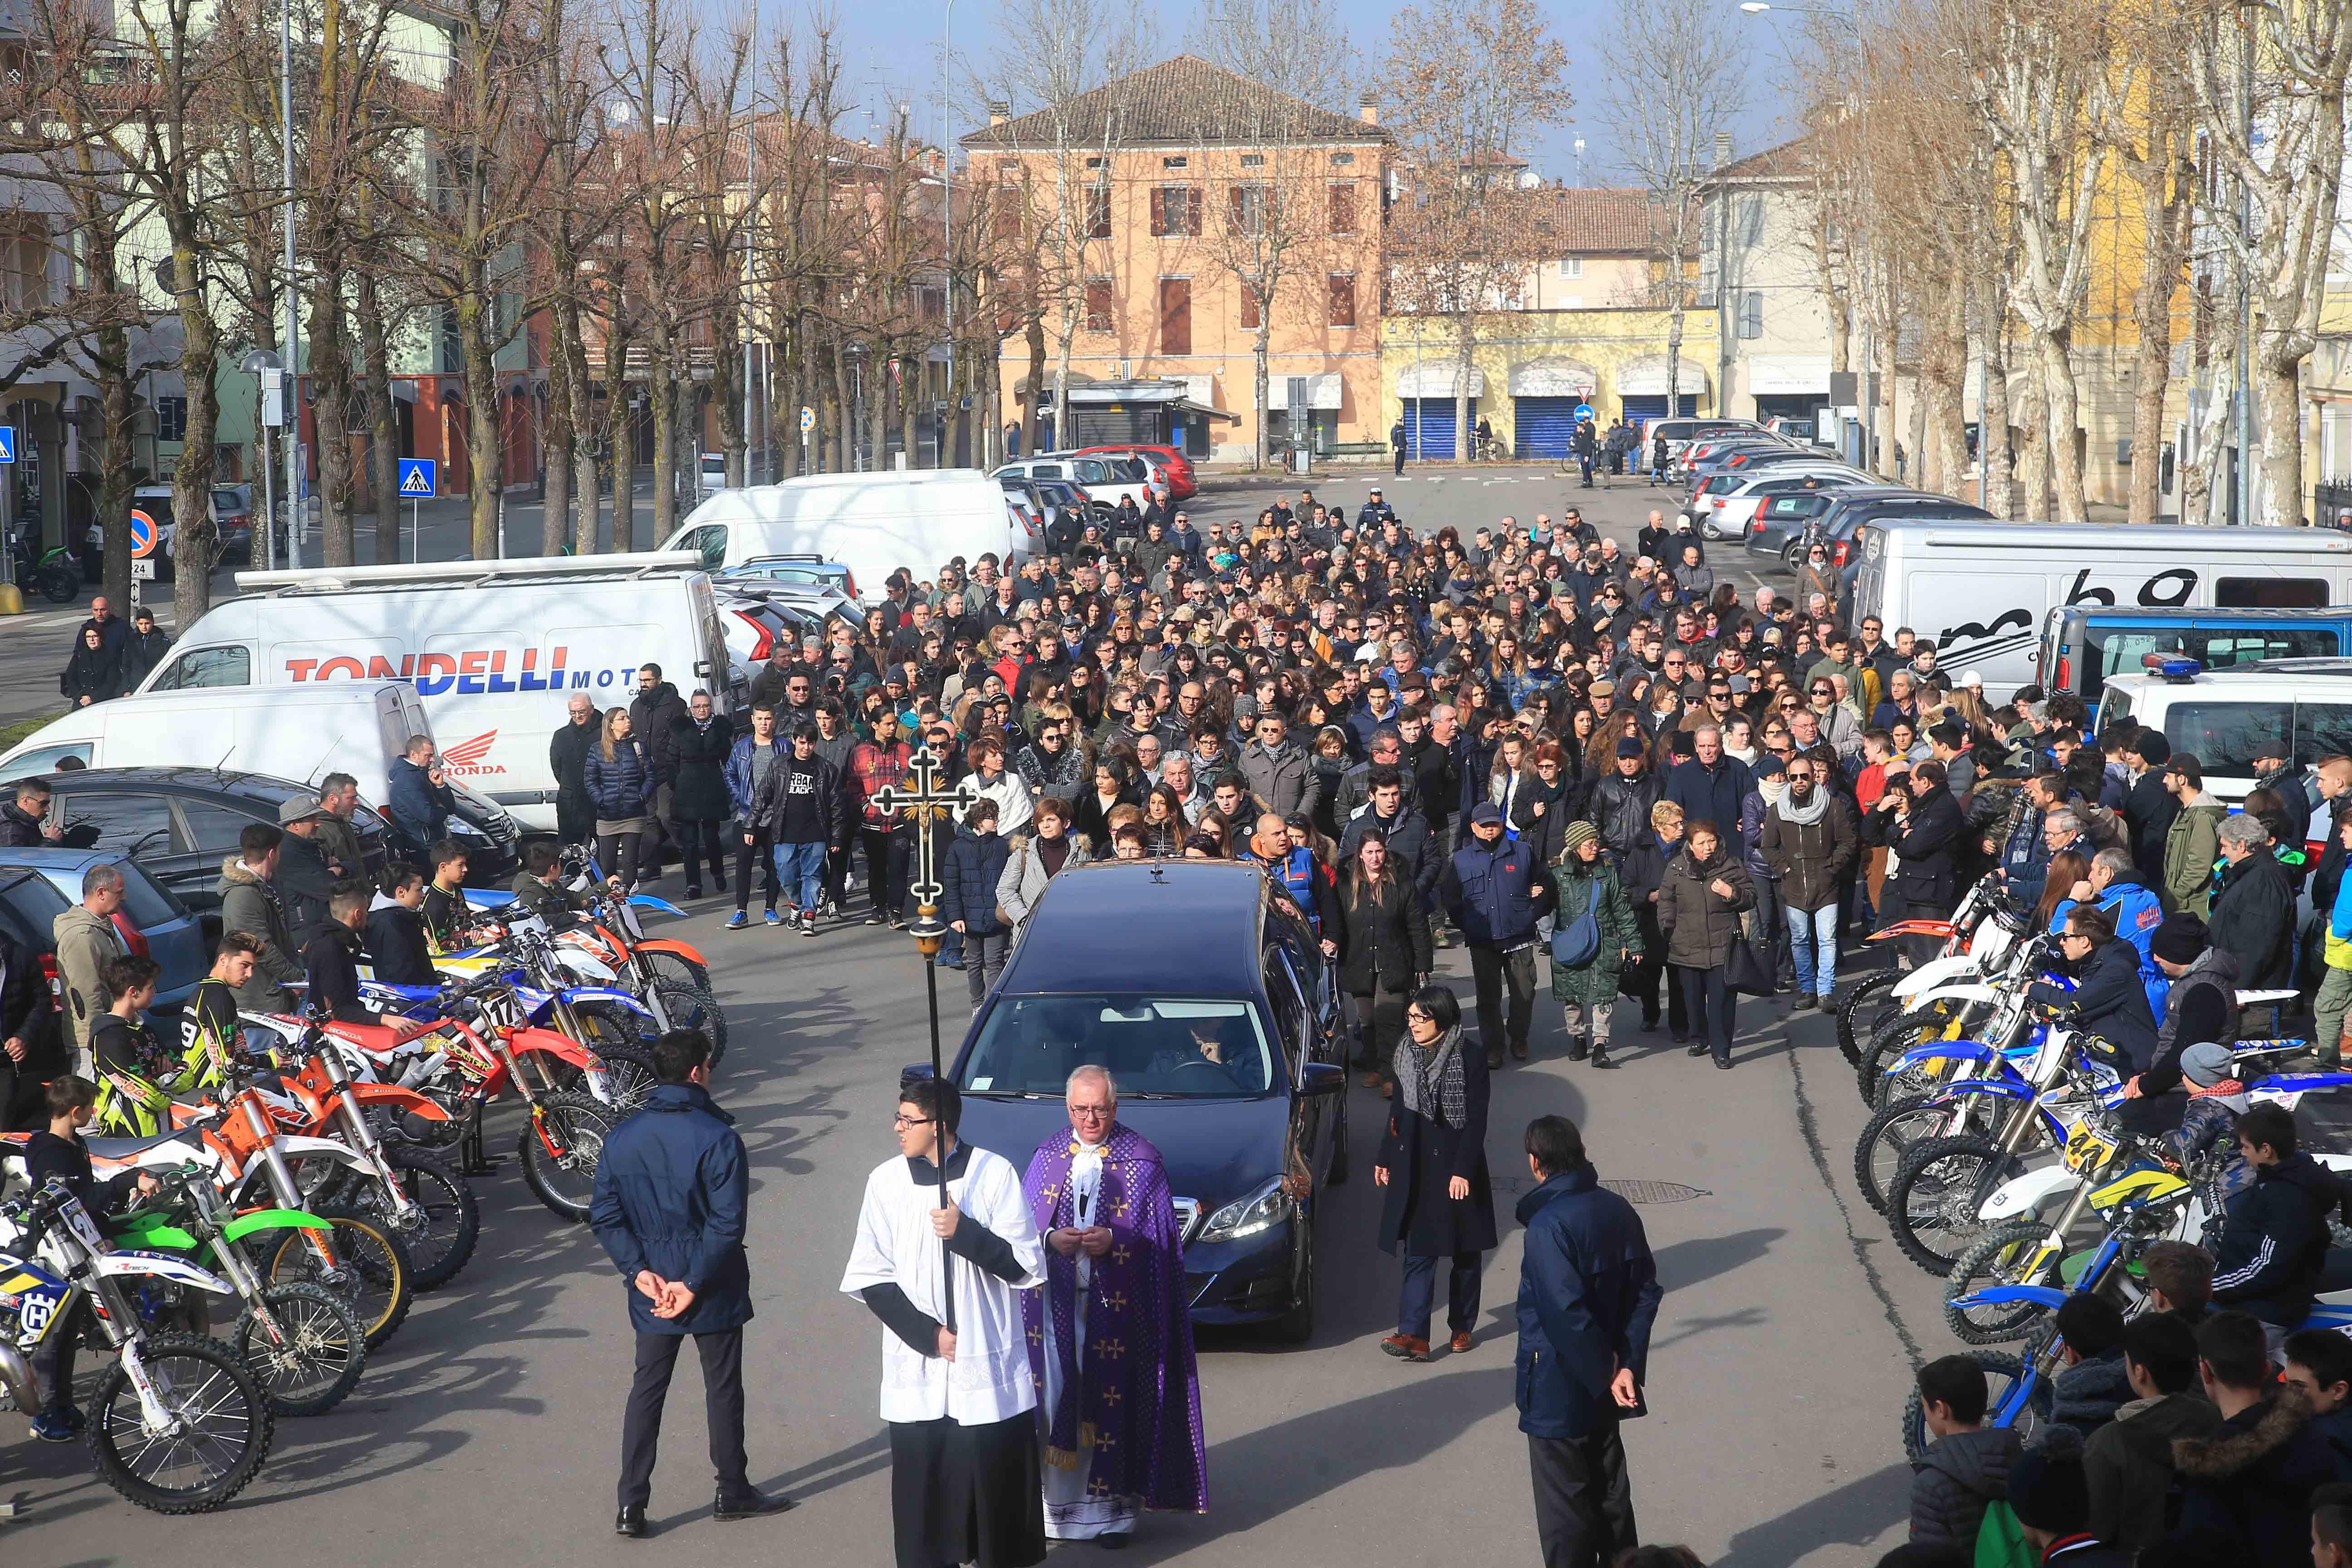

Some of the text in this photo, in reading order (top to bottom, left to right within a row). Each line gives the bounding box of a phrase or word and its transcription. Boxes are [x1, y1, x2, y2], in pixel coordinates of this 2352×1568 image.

[441, 765, 507, 778] HONDA
[490, 995, 513, 1026] 17
[262, 1018, 294, 1030] DUNLOP
[328, 1026, 363, 1041] HONDA
[1983, 1085, 2008, 1095] YAMAHA
[2207, 1183, 2221, 1216] RENTHAL
